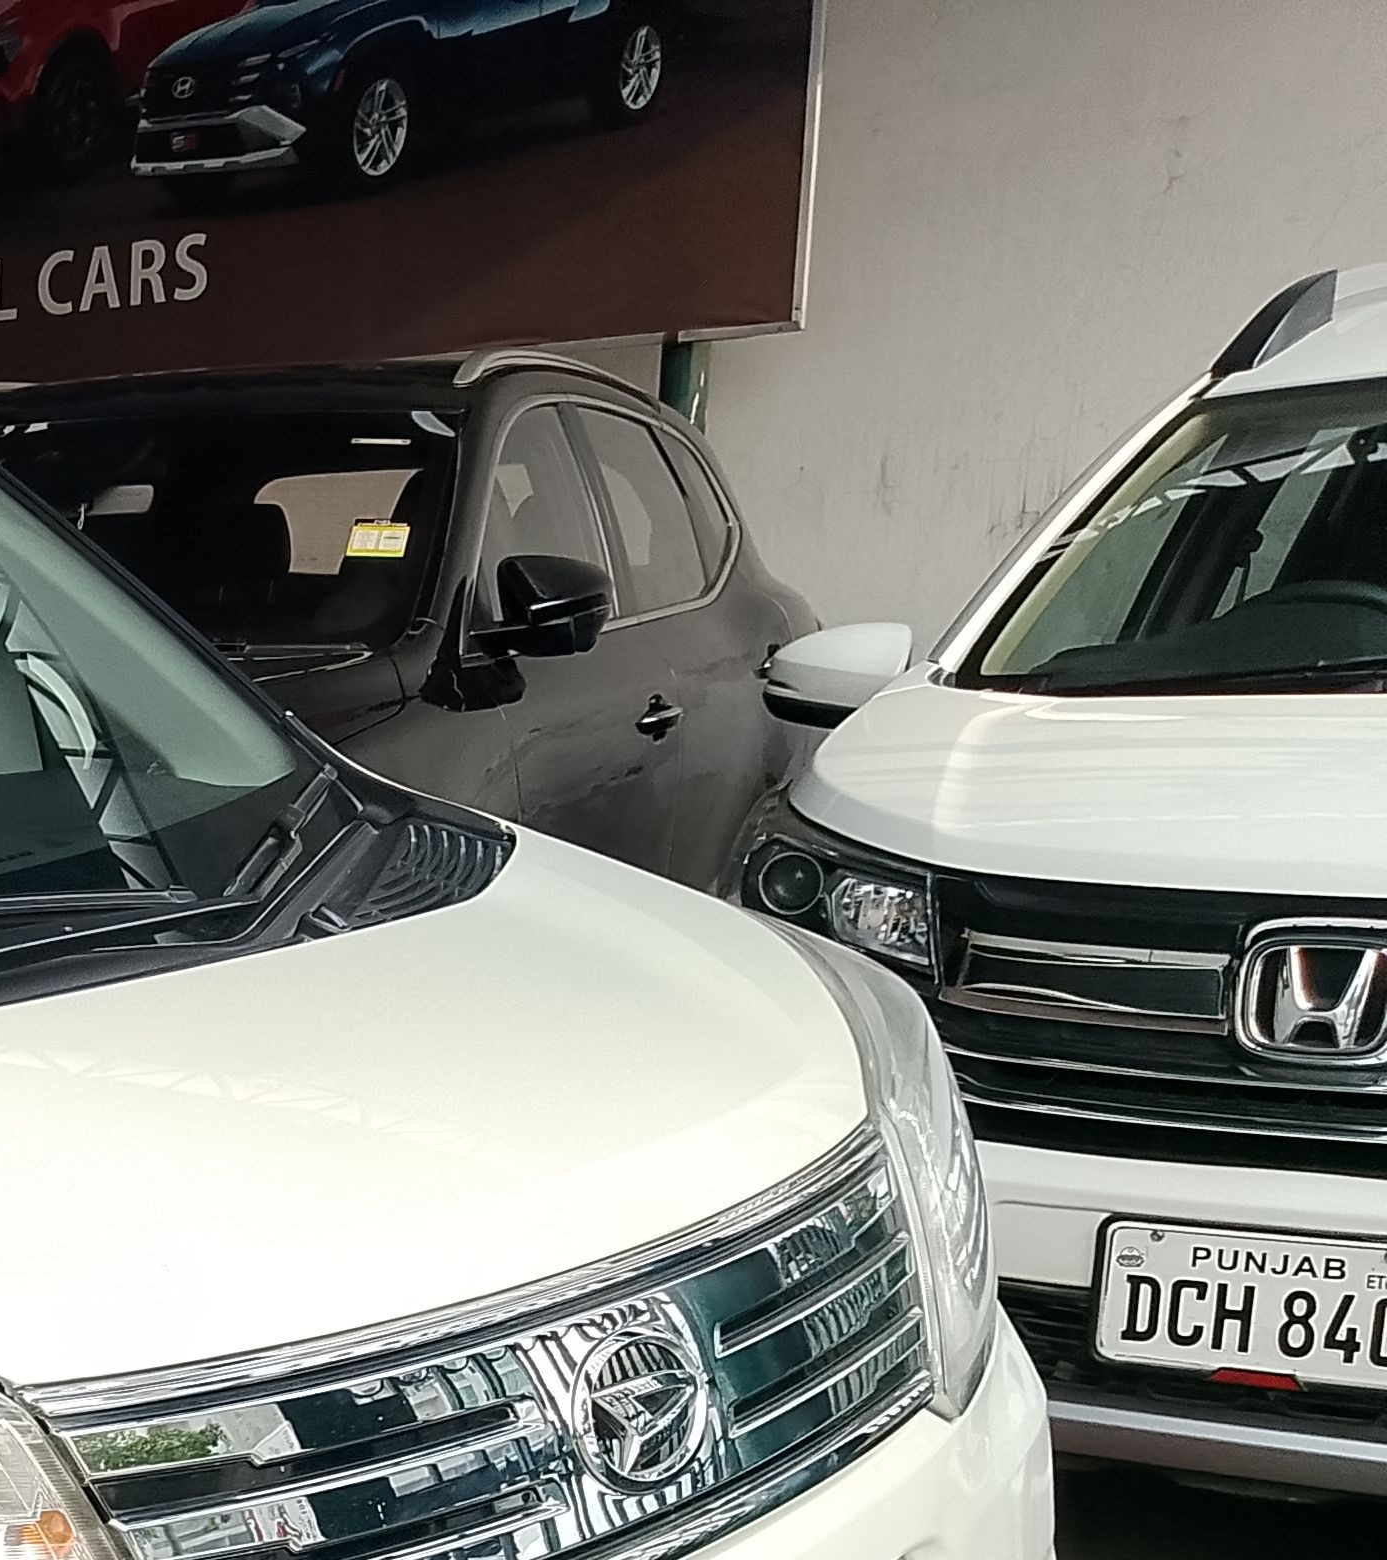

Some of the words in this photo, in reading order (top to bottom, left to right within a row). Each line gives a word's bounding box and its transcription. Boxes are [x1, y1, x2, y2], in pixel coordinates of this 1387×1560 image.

[38, 233, 210, 316] CARS
[1190, 1246, 1347, 1281] PUNJAB
[1120, 1274, 1256, 1353] DCH
